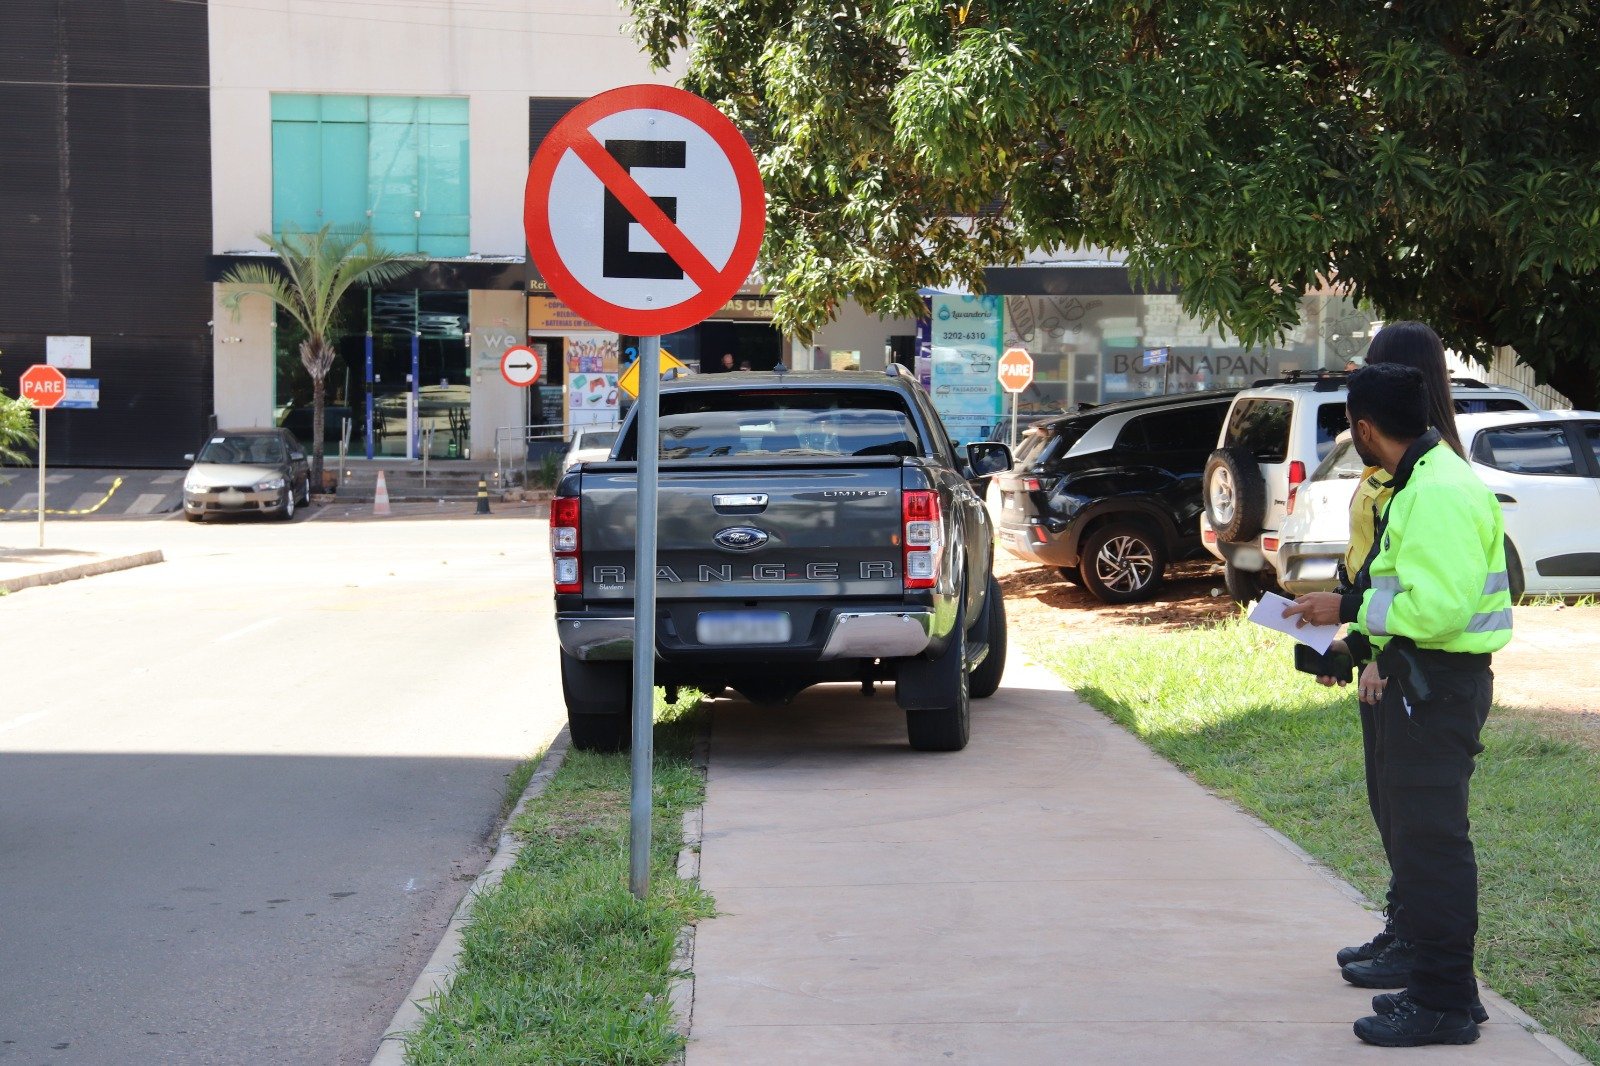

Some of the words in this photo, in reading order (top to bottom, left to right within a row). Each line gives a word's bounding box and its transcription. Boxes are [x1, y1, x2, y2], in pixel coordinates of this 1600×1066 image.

[603, 140, 686, 280] E
[721, 299, 743, 311] AS
[545, 319, 573, 327] BATERIAS
[483, 334, 517, 349] we
[943, 332, 986, 340] 3202-6310
[1000, 363, 1031, 377] PARE
[24, 380, 63, 393] PARE
[1158, 381, 1174, 389] DA
[728, 532, 750, 543] Ford
[593, 560, 894, 583] RANGER
